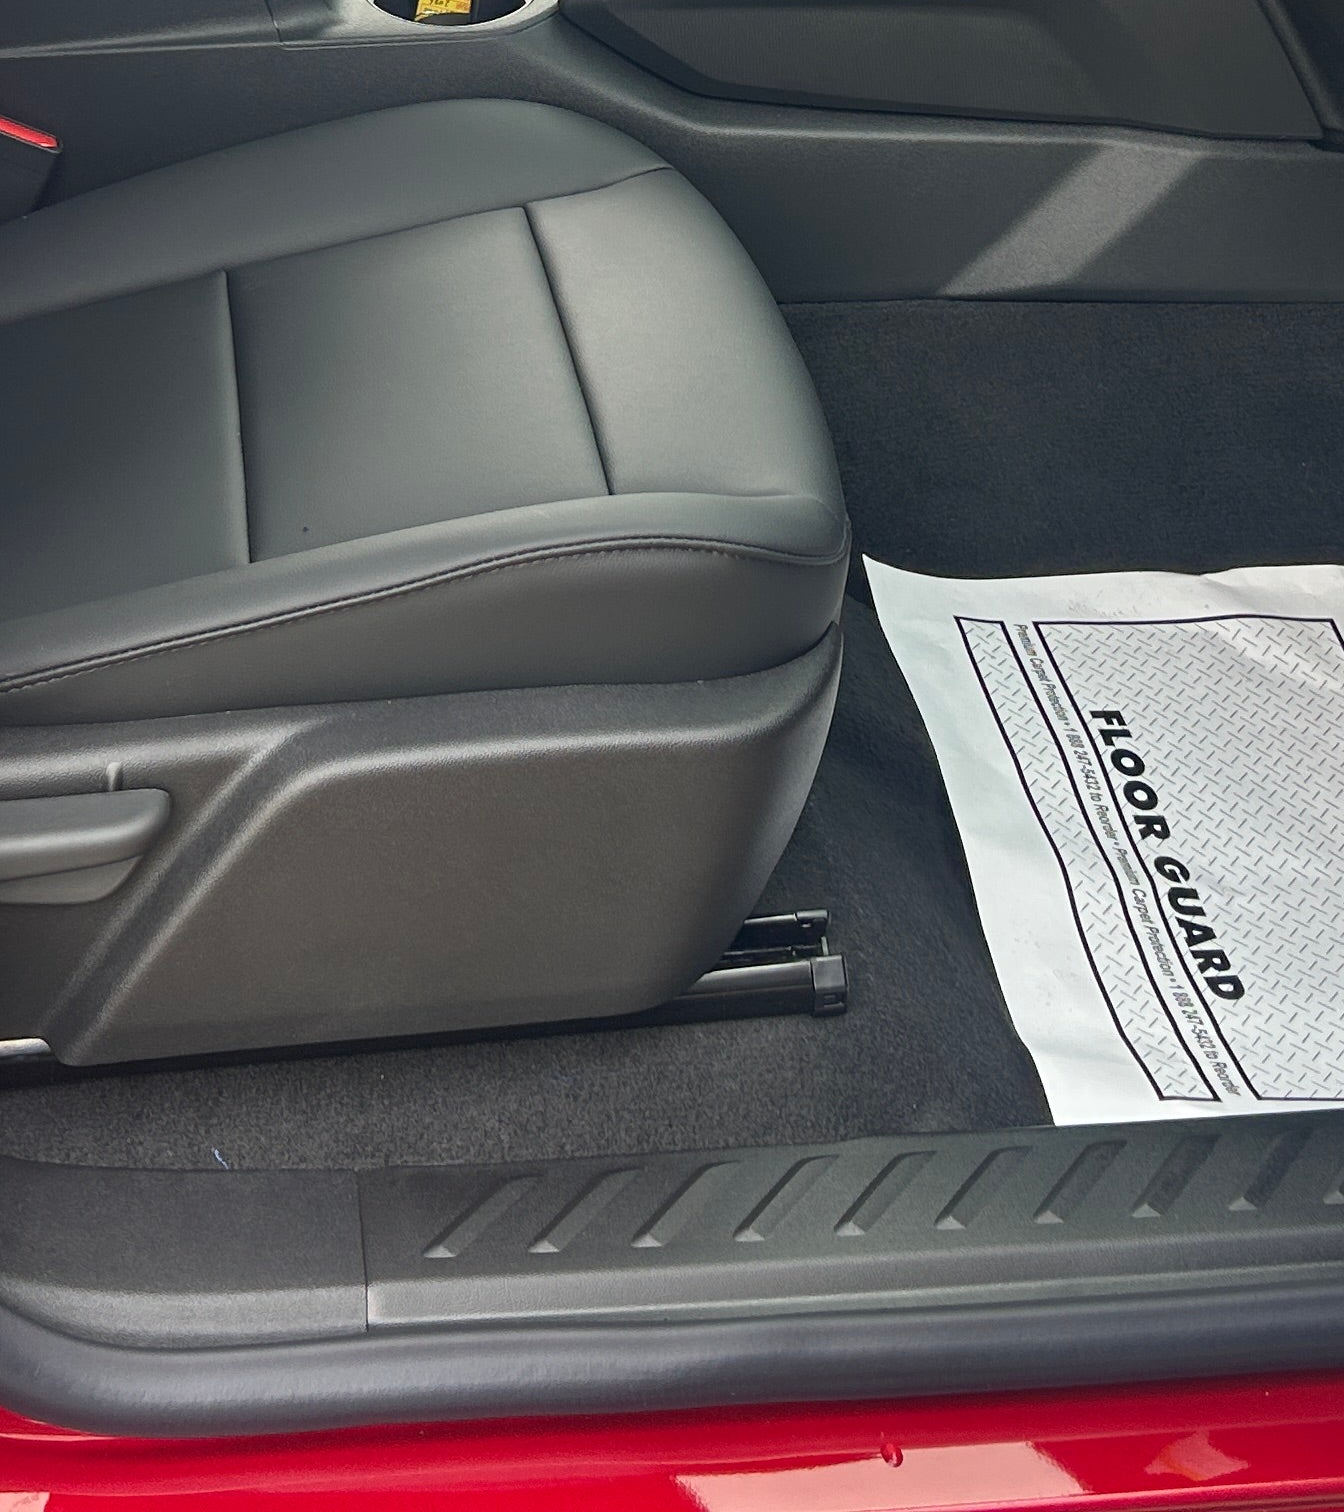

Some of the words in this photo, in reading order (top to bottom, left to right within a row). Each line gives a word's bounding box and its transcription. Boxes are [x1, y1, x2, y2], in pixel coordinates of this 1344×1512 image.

[1089, 710, 1171, 840] FLOOR
[1154, 855, 1245, 1000] GUARD
[1089, 792, 1103, 802] to
[1131, 888, 1154, 925] Carpet
[1146, 926, 1174, 977] Protection
